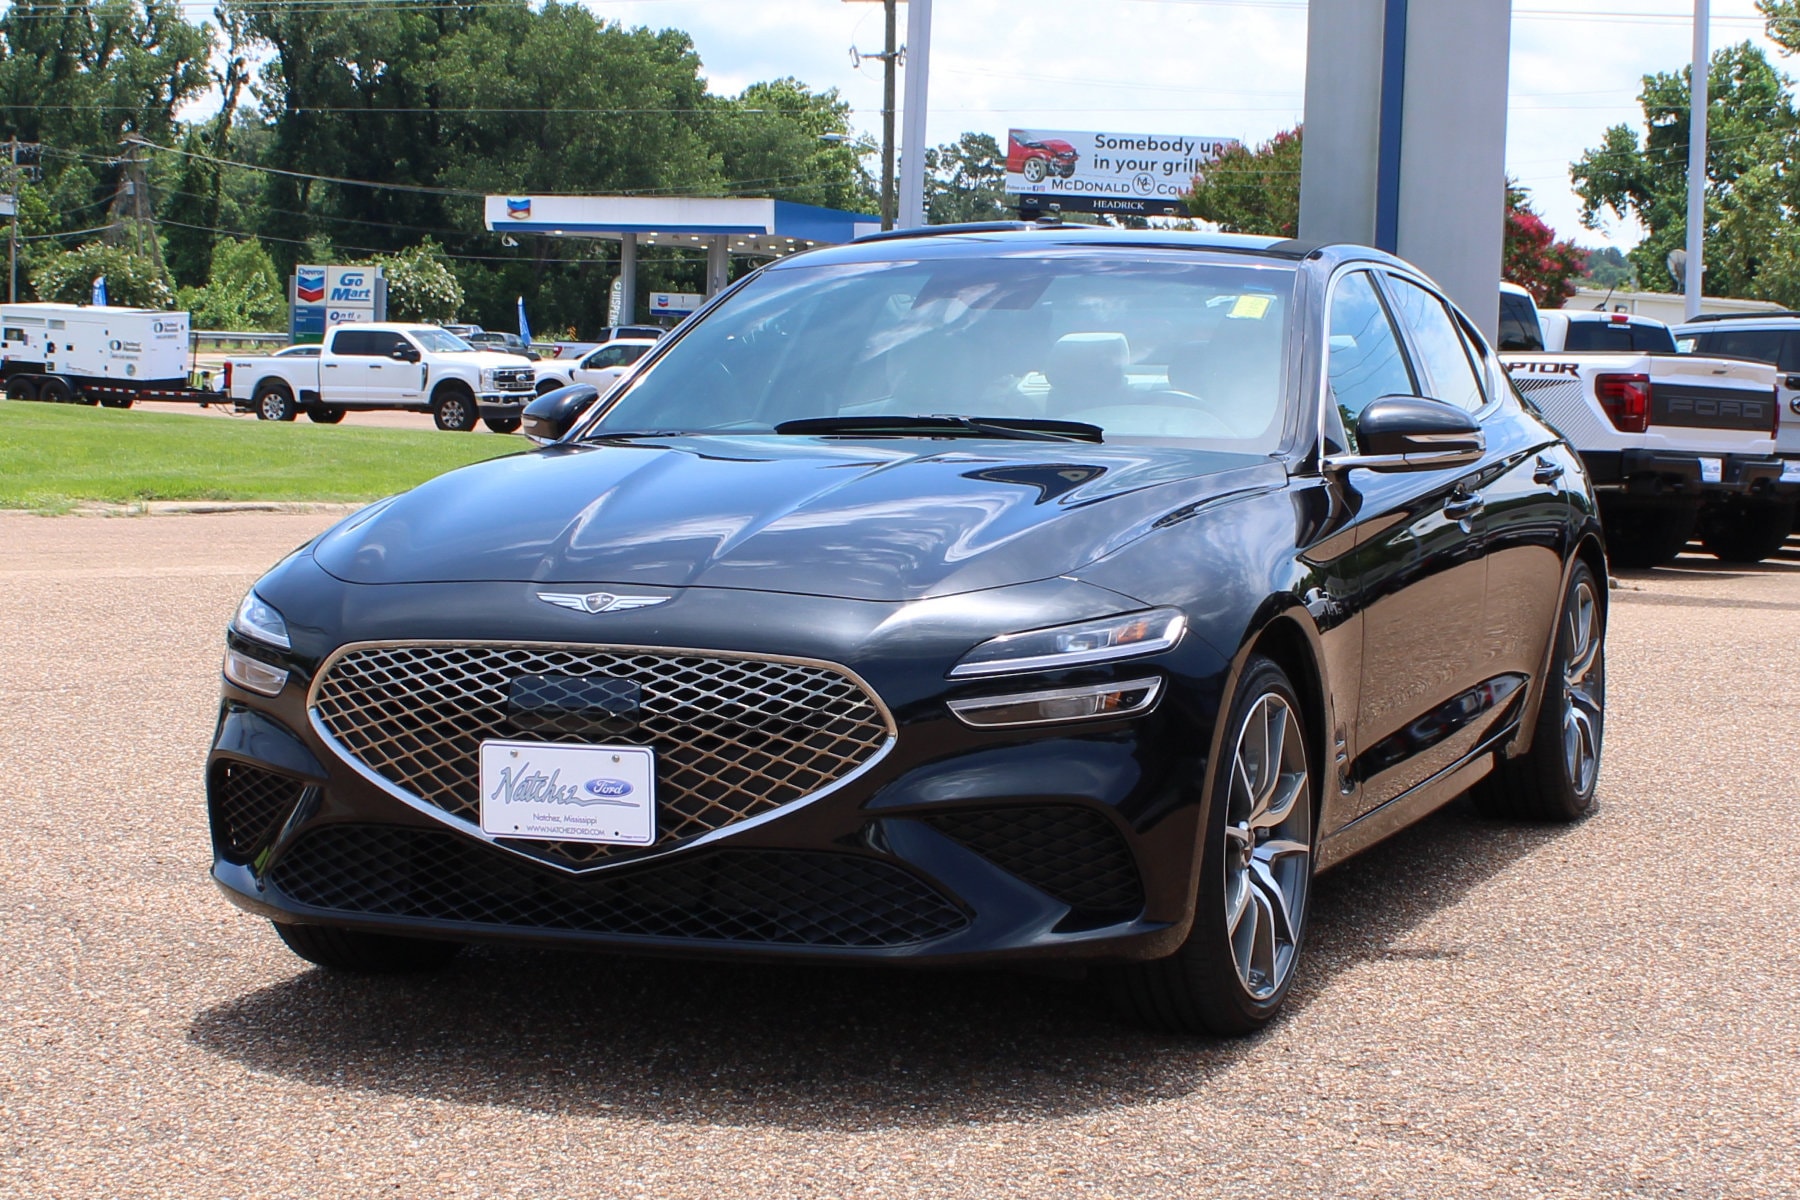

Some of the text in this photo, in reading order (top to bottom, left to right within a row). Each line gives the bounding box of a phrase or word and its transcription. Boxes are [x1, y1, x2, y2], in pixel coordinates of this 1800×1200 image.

[1095, 134, 1195, 154] Somebody
[1094, 154, 1199, 176] in your grill
[1093, 200, 1145, 210] HEADRICK
[298, 267, 325, 276] Chevron
[339, 272, 364, 287] Go
[330, 287, 371, 302] Mart
[1669, 399, 1764, 418] FORD
[491, 761, 625, 806] Natchez Ford
[532, 812, 598, 826] Natchez, Mississippi
